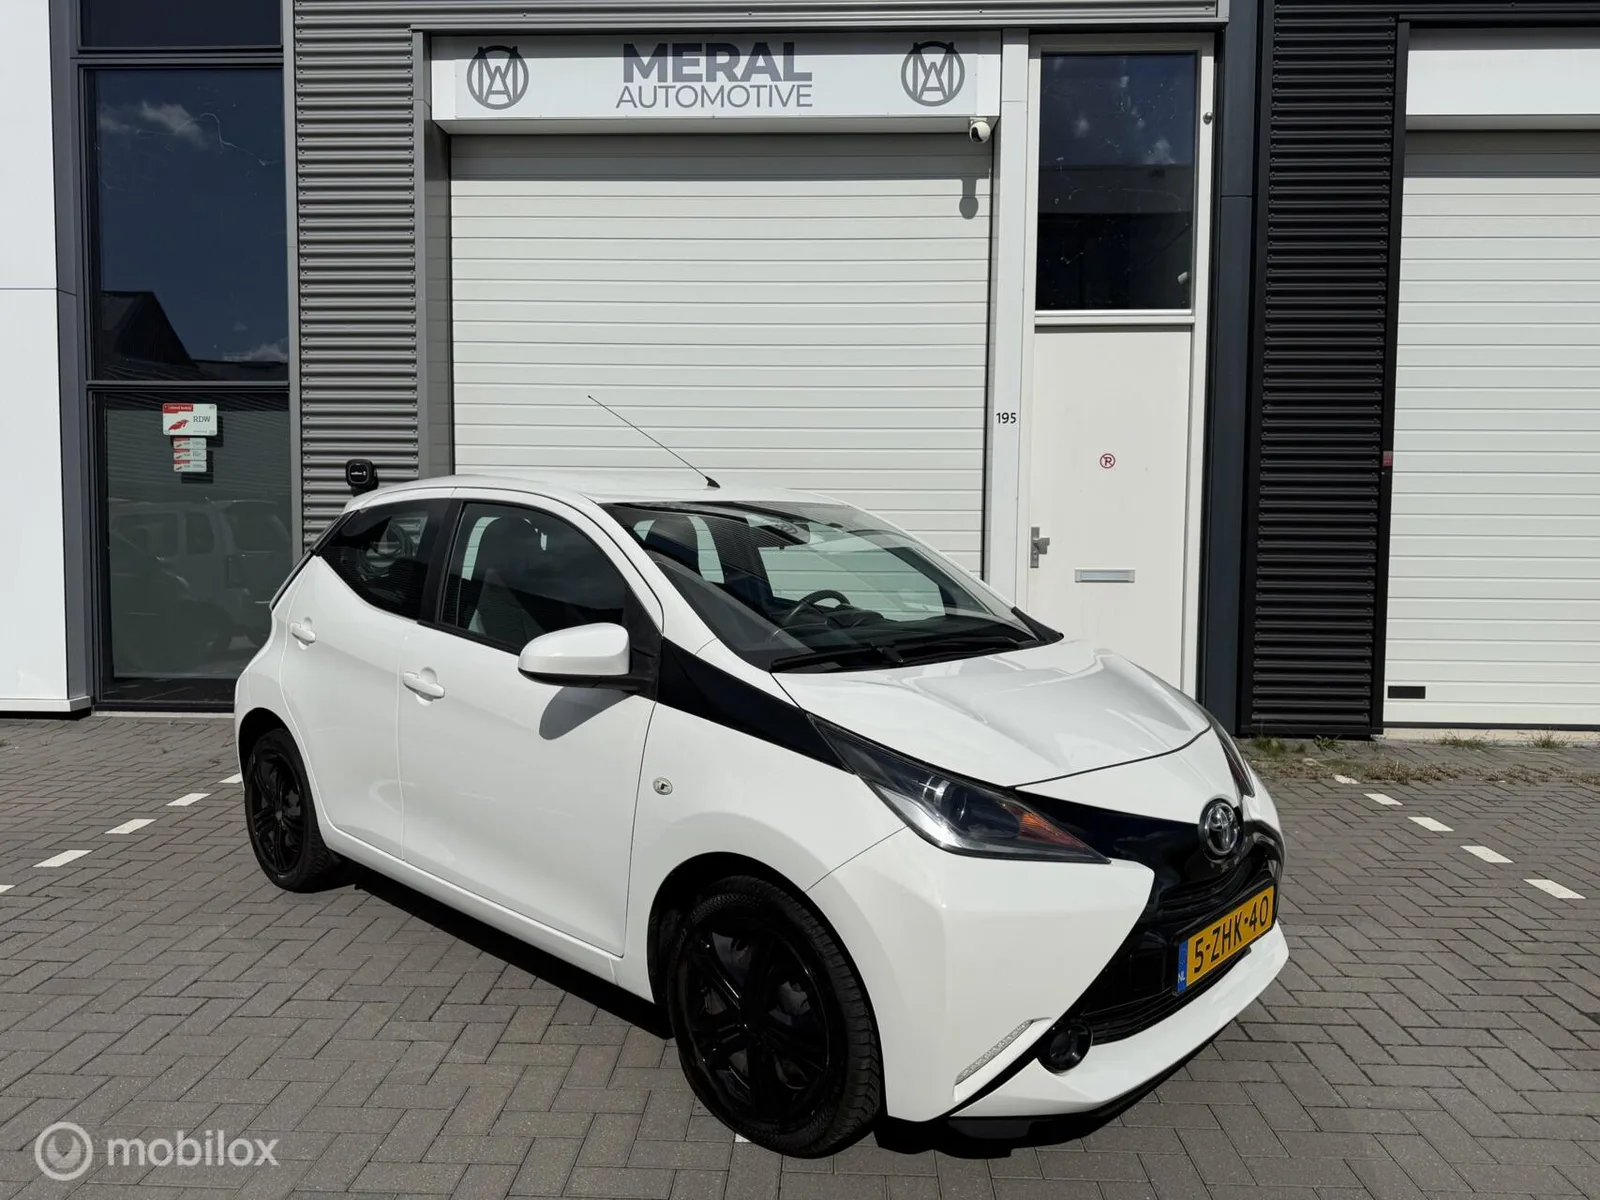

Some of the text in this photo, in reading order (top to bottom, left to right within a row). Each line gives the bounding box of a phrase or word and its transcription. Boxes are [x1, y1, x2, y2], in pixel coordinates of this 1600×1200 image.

[623, 42, 813, 83] MERAL
[615, 84, 813, 109] AUTOMOTIVE
[996, 412, 1017, 424] 195
[1193, 895, 1269, 974] 5-ZHK-40
